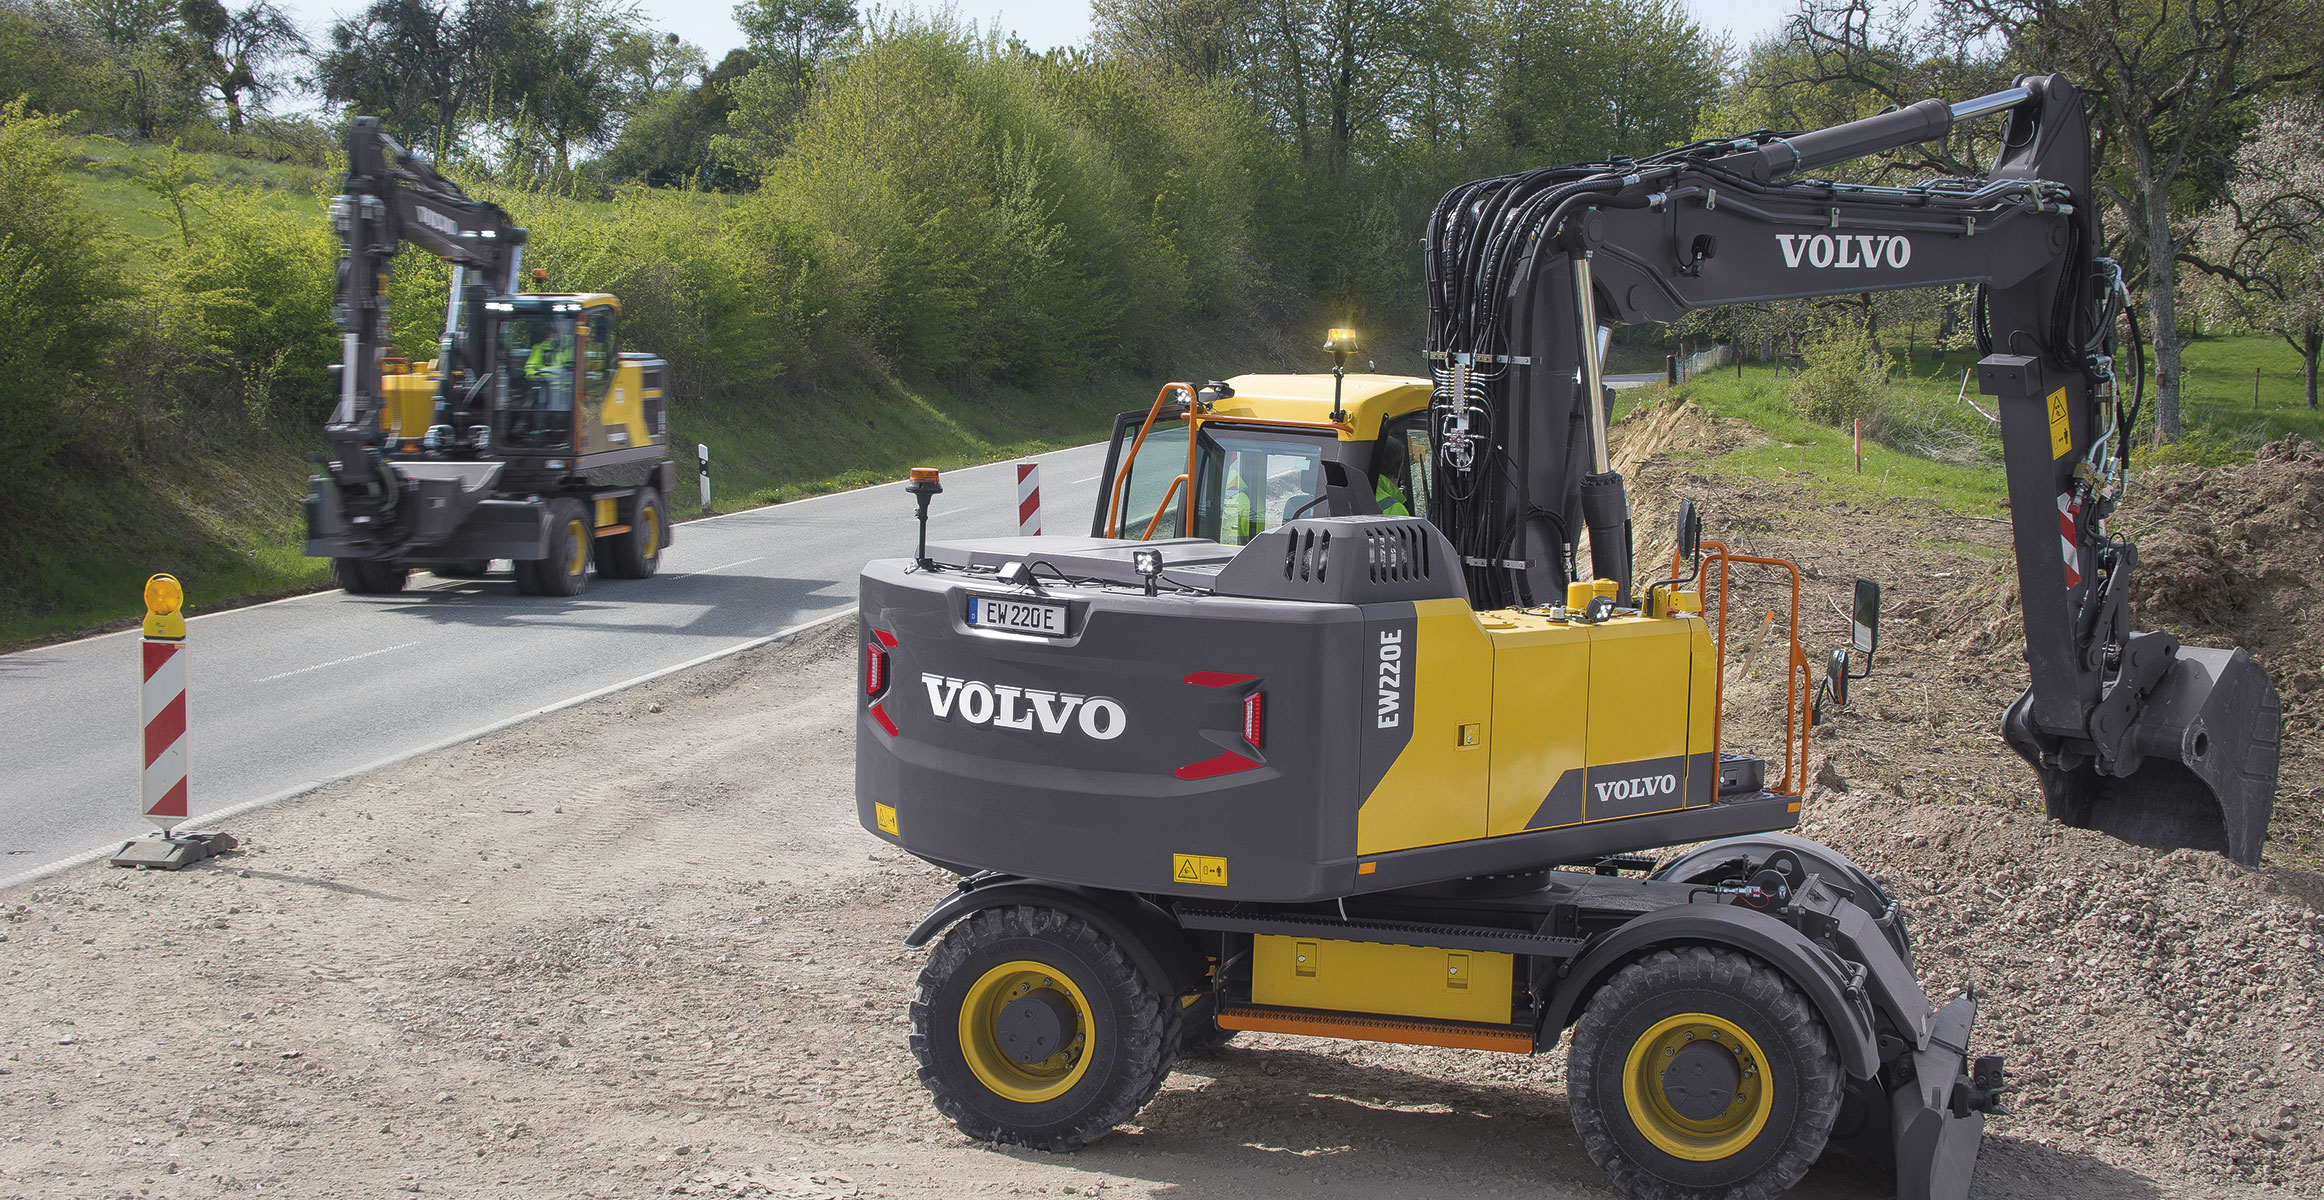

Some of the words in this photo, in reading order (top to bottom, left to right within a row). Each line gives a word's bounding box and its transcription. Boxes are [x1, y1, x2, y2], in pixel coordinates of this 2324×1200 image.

[1775, 234, 1911, 269] VOLVO
[987, 602, 1008, 625] EW
[1010, 605, 1041, 628] 220
[1044, 608, 1054, 630] E
[1377, 629, 1402, 729] EW220E
[921, 672, 1127, 740] VOLVO
[1594, 774, 1676, 802] VOLVO
